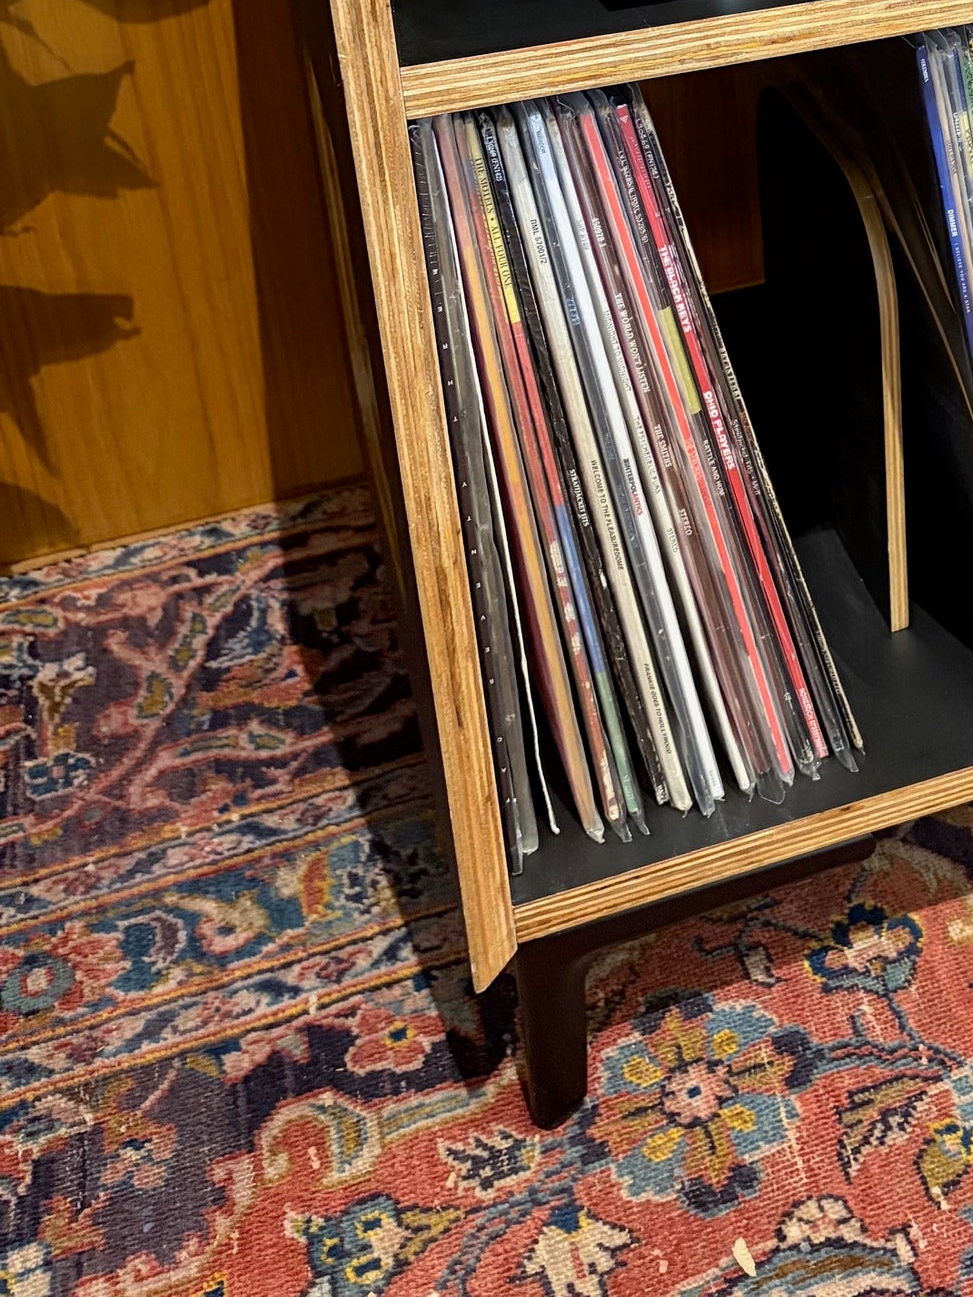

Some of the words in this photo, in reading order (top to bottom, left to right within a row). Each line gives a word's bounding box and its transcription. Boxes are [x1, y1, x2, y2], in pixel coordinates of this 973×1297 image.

[473, 156, 486, 175] THE
[945, 209, 958, 237] DIMMER
[658, 244, 672, 266] THE
[663, 265, 685, 302] BLACK
[612, 292, 626, 309] THE
[618, 315, 635, 339] WORLD
[675, 302, 692, 333] KEYS
[634, 365, 651, 394] LISTEN
[651, 423, 664, 438] THE
[701, 390, 719, 419] OHIO
[711, 418, 736, 471] PLAYERS
[656, 438, 673, 468] SMITHS
[701, 438, 715, 465] RATTLE
[589, 458, 604, 494] WELCOME
[709, 465, 721, 481] AND
[598, 493, 607, 504] TO
[713, 480, 726, 497] HUM
[600, 503, 611, 519] THE
[677, 507, 693, 536] STEREO
[642, 662, 655, 690] FRANKIE
[654, 707, 662, 716] TO
